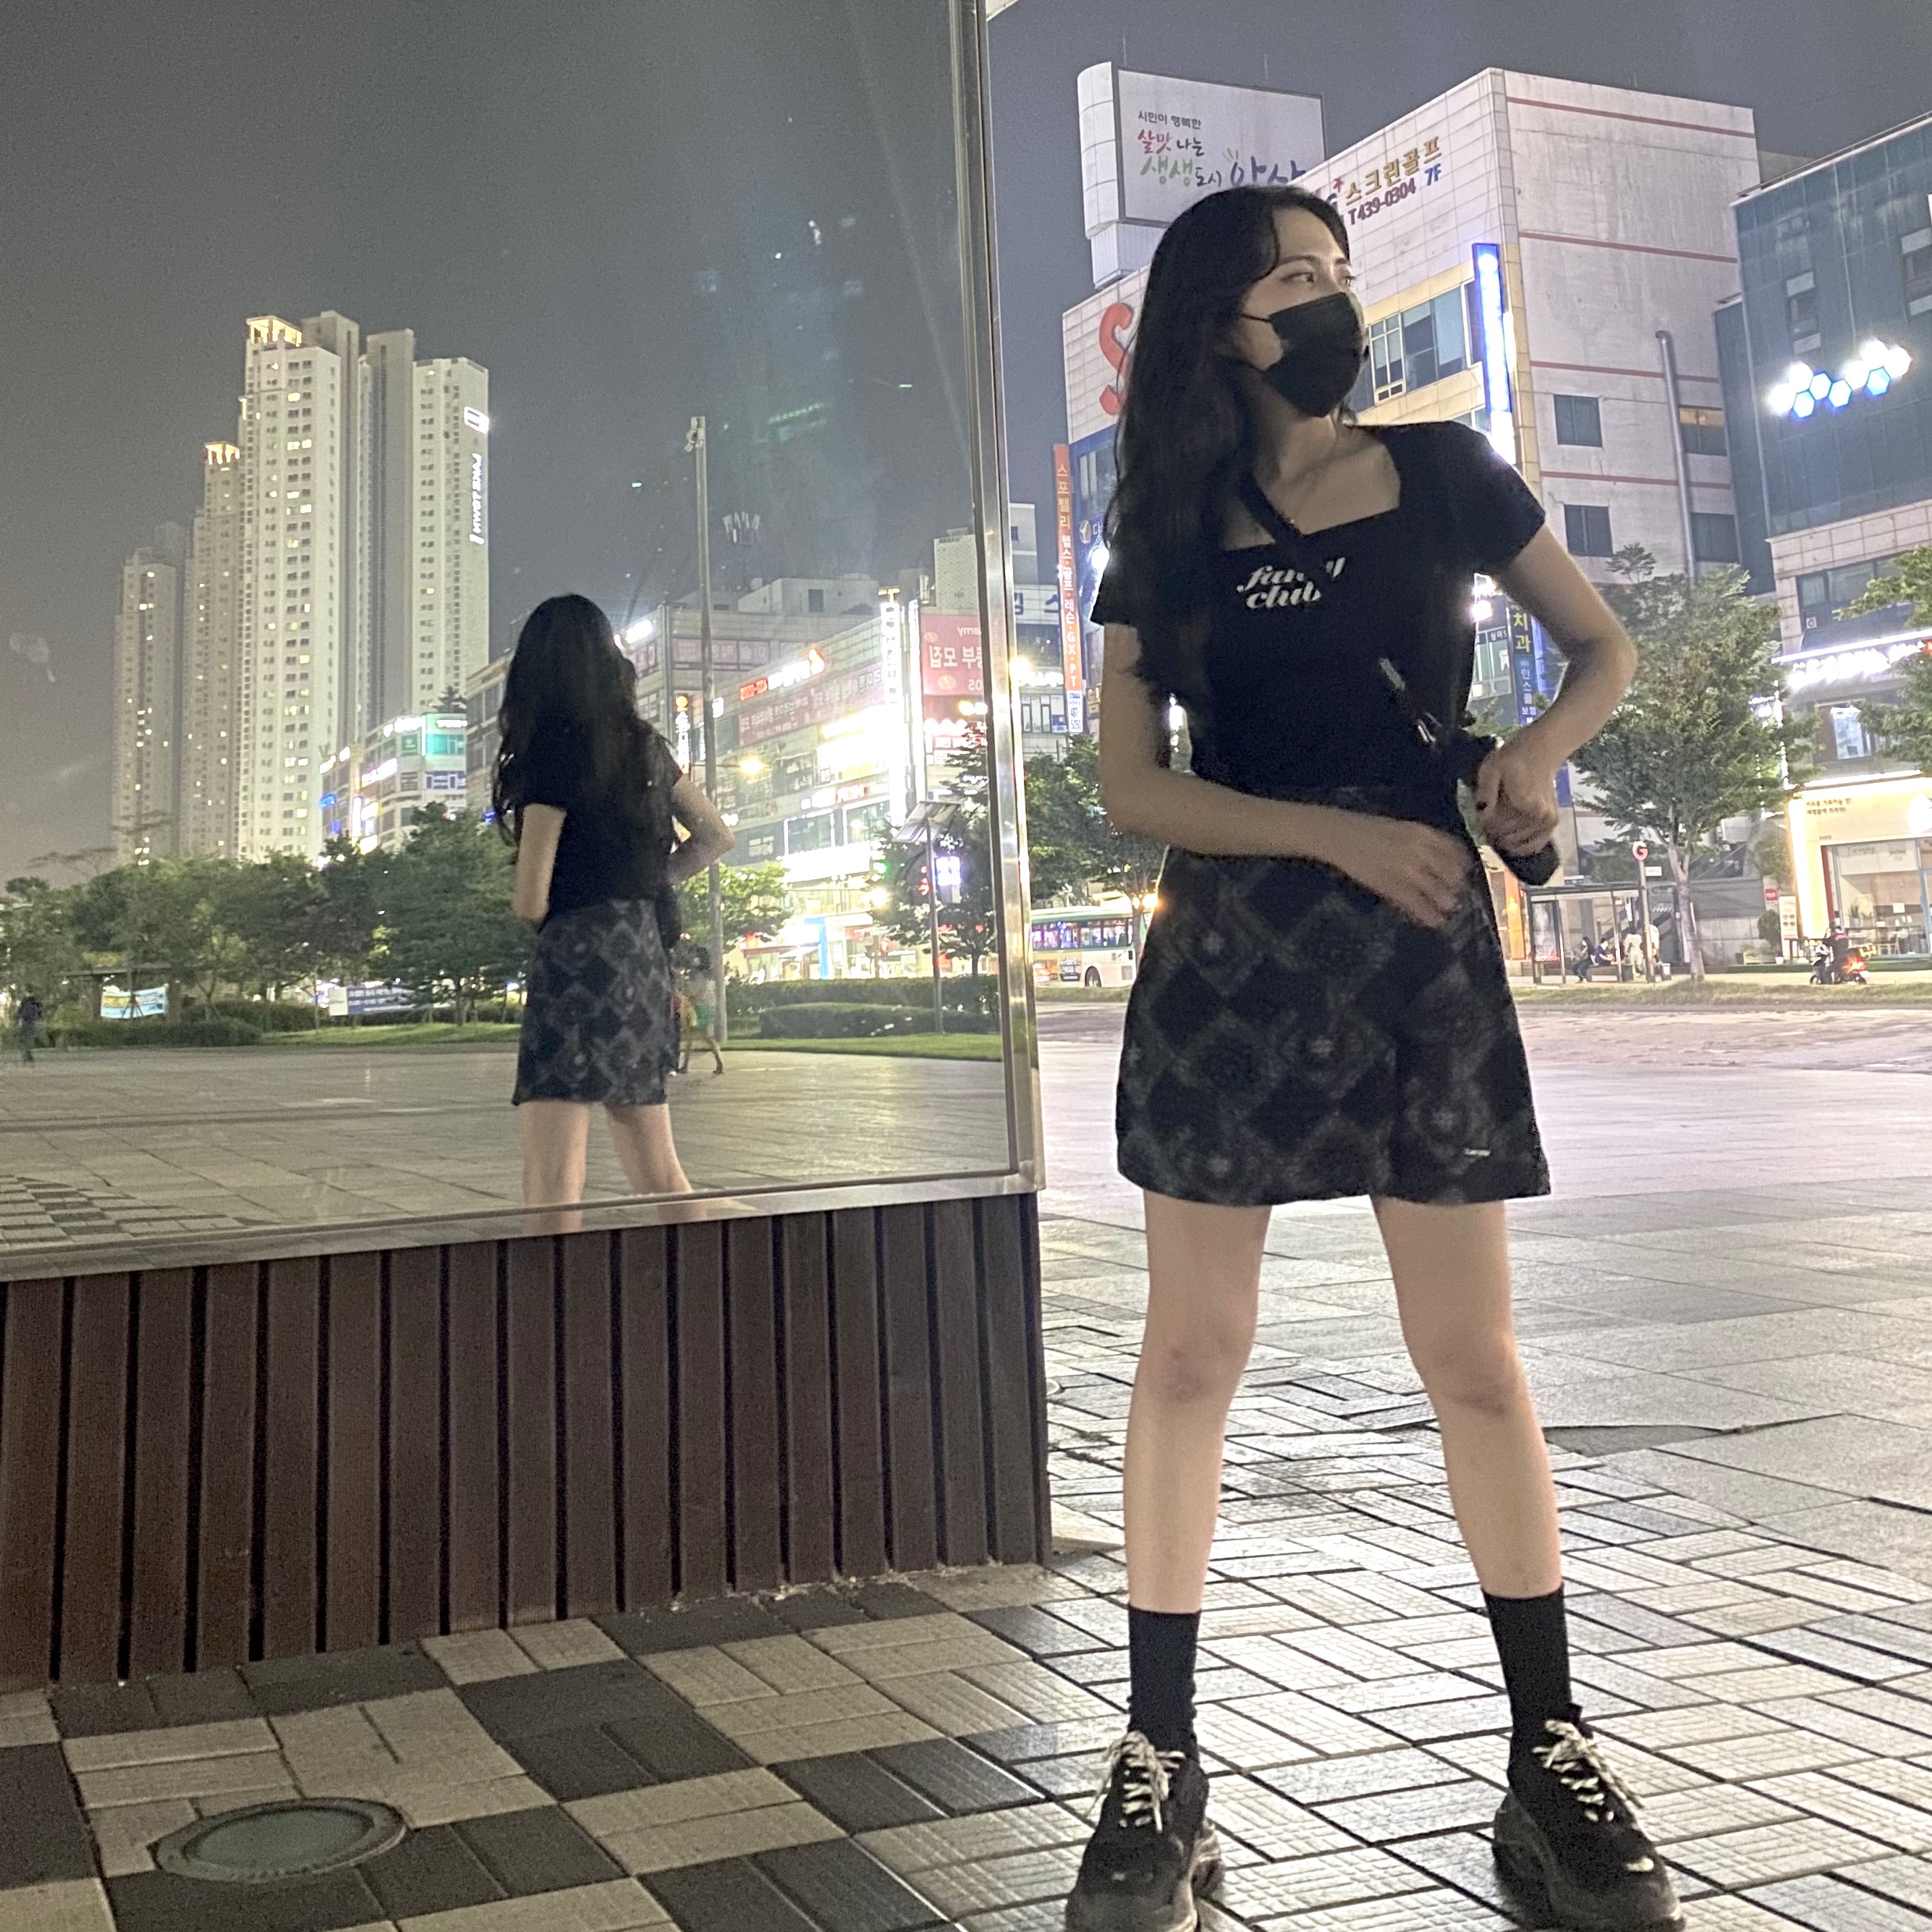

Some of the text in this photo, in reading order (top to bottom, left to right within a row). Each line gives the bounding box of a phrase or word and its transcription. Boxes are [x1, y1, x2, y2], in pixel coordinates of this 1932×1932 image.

[1137, 111, 1201, 130] 시민이 행복한
[1137, 129, 1205, 157] 살맛 나는
[1346, 137, 1442, 206] 스크린골프
[1348, 177, 1416, 226] T439-0304
[1425, 163, 1442, 186] 7F
